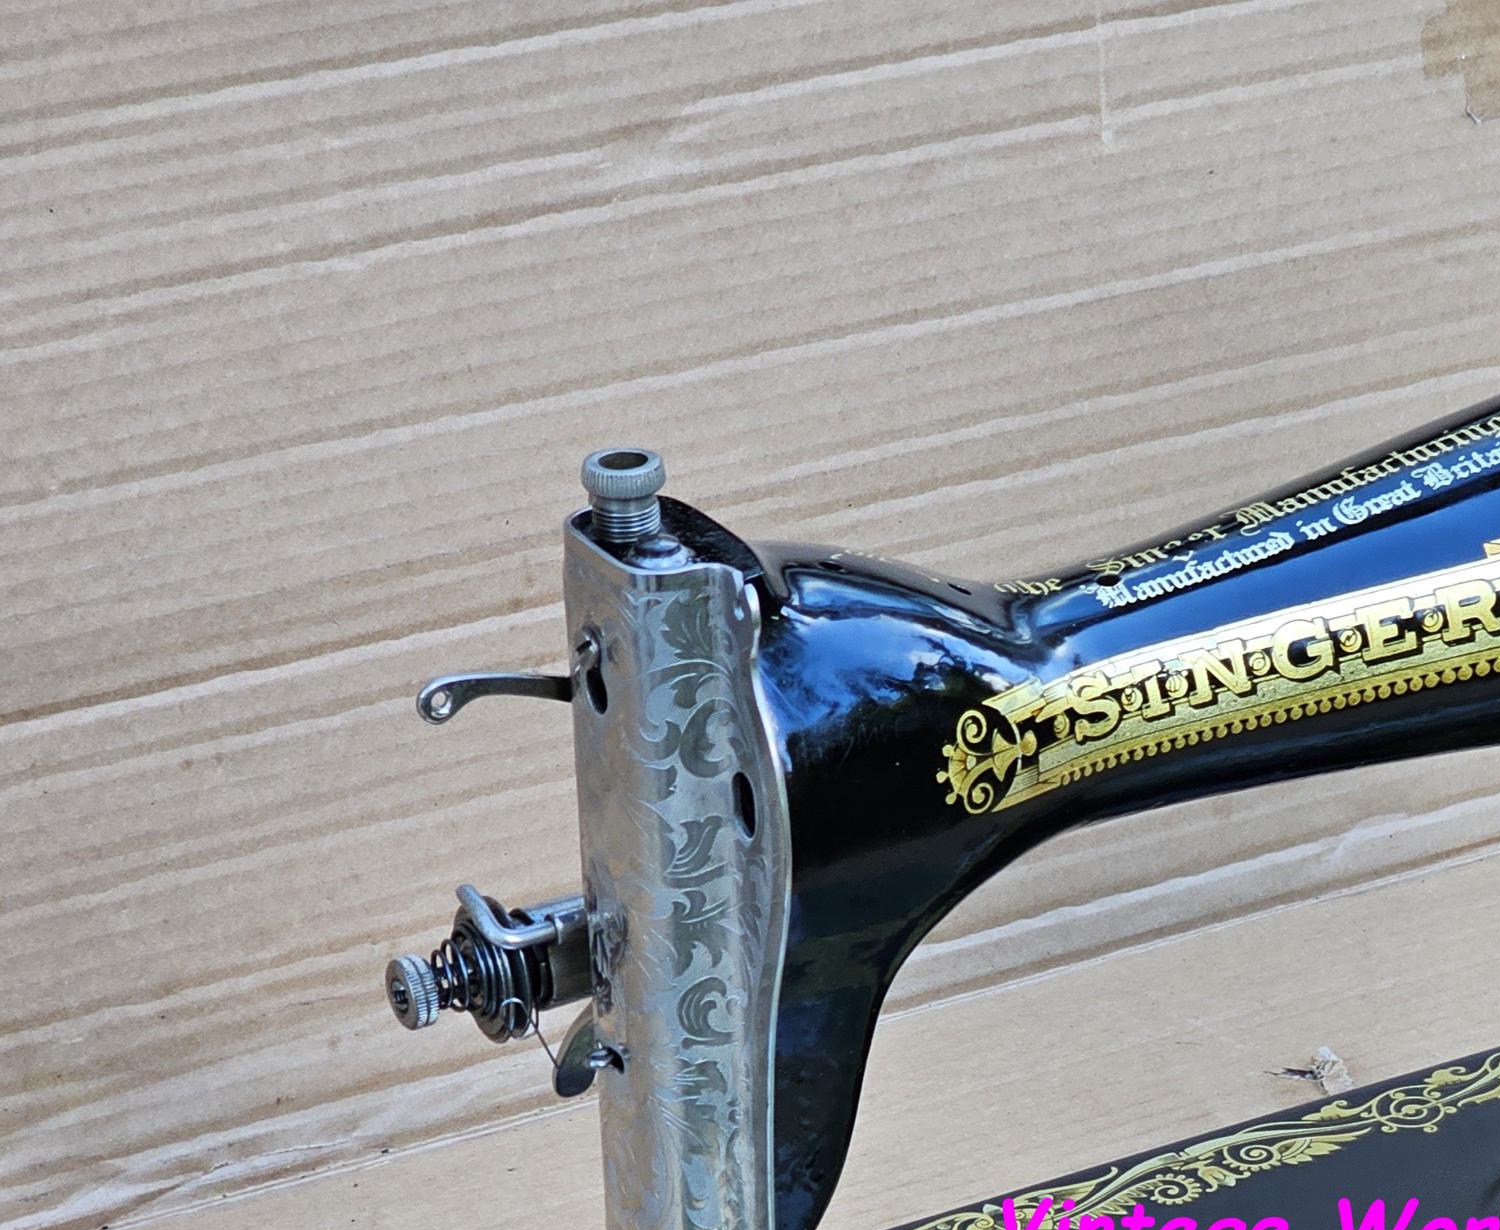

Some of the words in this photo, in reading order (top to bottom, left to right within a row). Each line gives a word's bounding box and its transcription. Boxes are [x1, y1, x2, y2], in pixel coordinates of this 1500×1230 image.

[1079, 530, 1296, 608] Manufactured
[1296, 518, 1338, 541] in
[1333, 481, 1421, 525] Great
